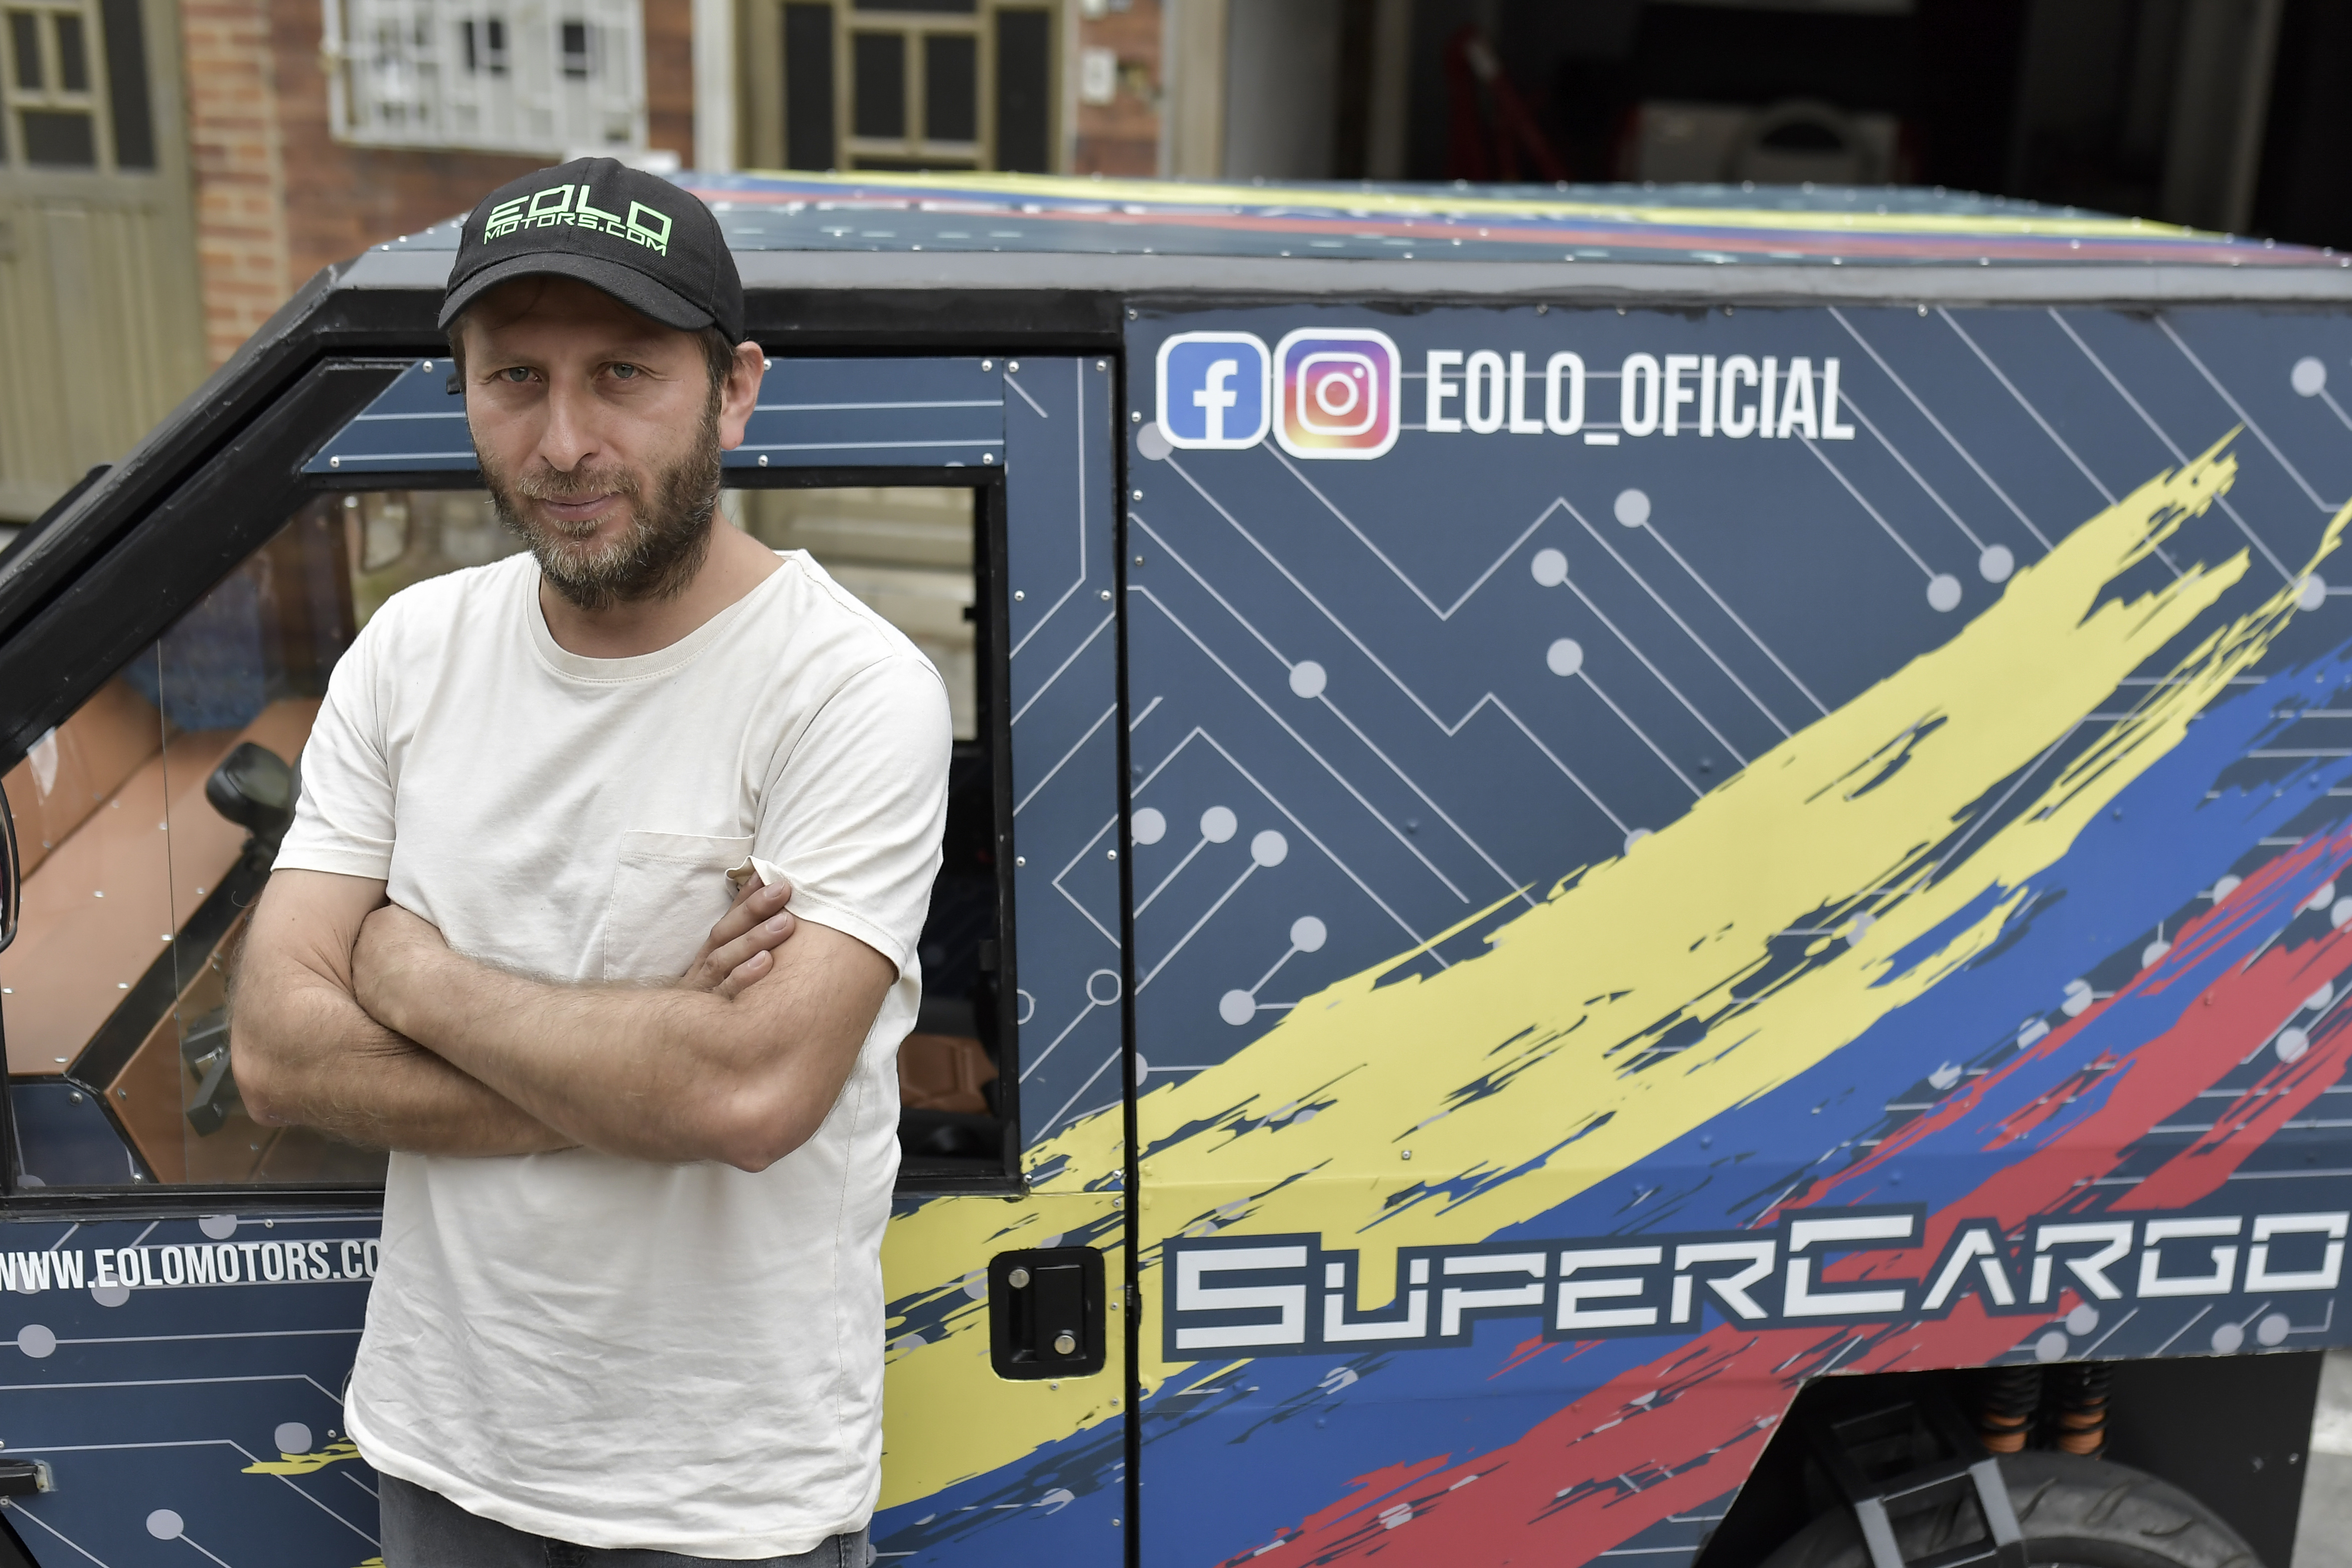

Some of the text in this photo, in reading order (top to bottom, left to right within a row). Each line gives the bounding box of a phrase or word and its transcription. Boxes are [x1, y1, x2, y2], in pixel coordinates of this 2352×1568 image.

[483, 212, 667, 256] MOTORS.COM
[485, 184, 672, 245] EOLO
[1426, 350, 1855, 445] EOLO_OFICIAL
